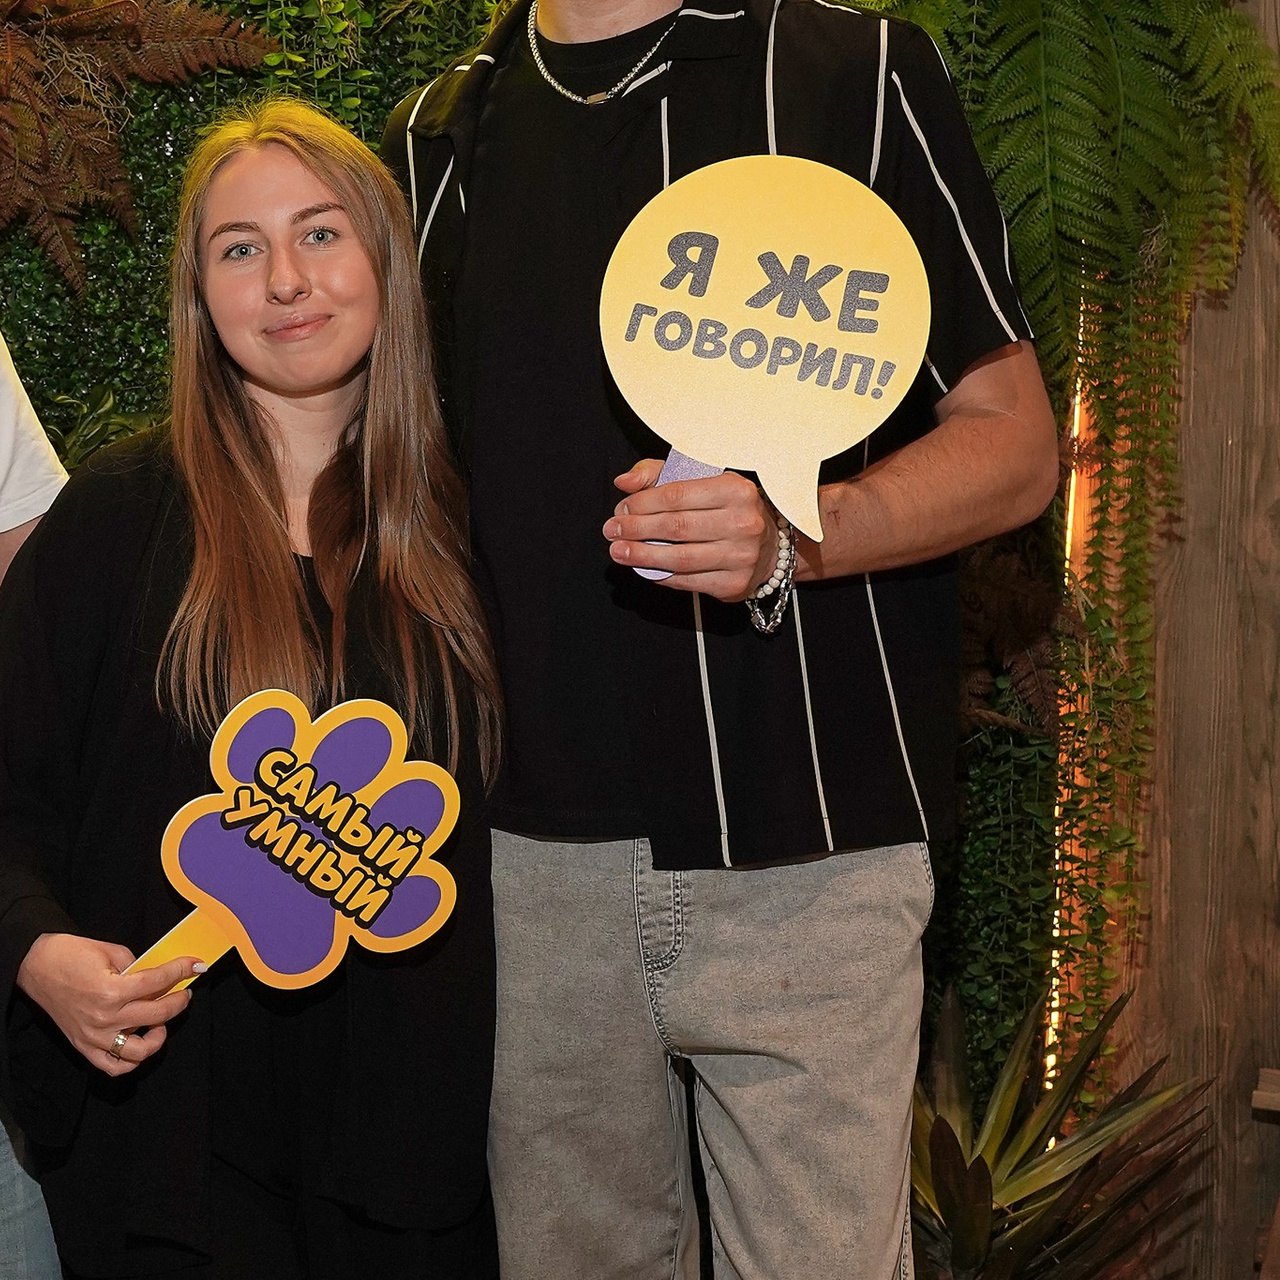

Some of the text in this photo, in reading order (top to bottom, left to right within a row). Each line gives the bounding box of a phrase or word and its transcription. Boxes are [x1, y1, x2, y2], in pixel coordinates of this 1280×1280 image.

[659, 231, 890, 334] Я ЖЕ
[624, 302, 897, 400] ГОВОРИЛ!
[222, 787, 393, 926] УМНЫЙ
[256, 748, 424, 881] САМЫЙ
